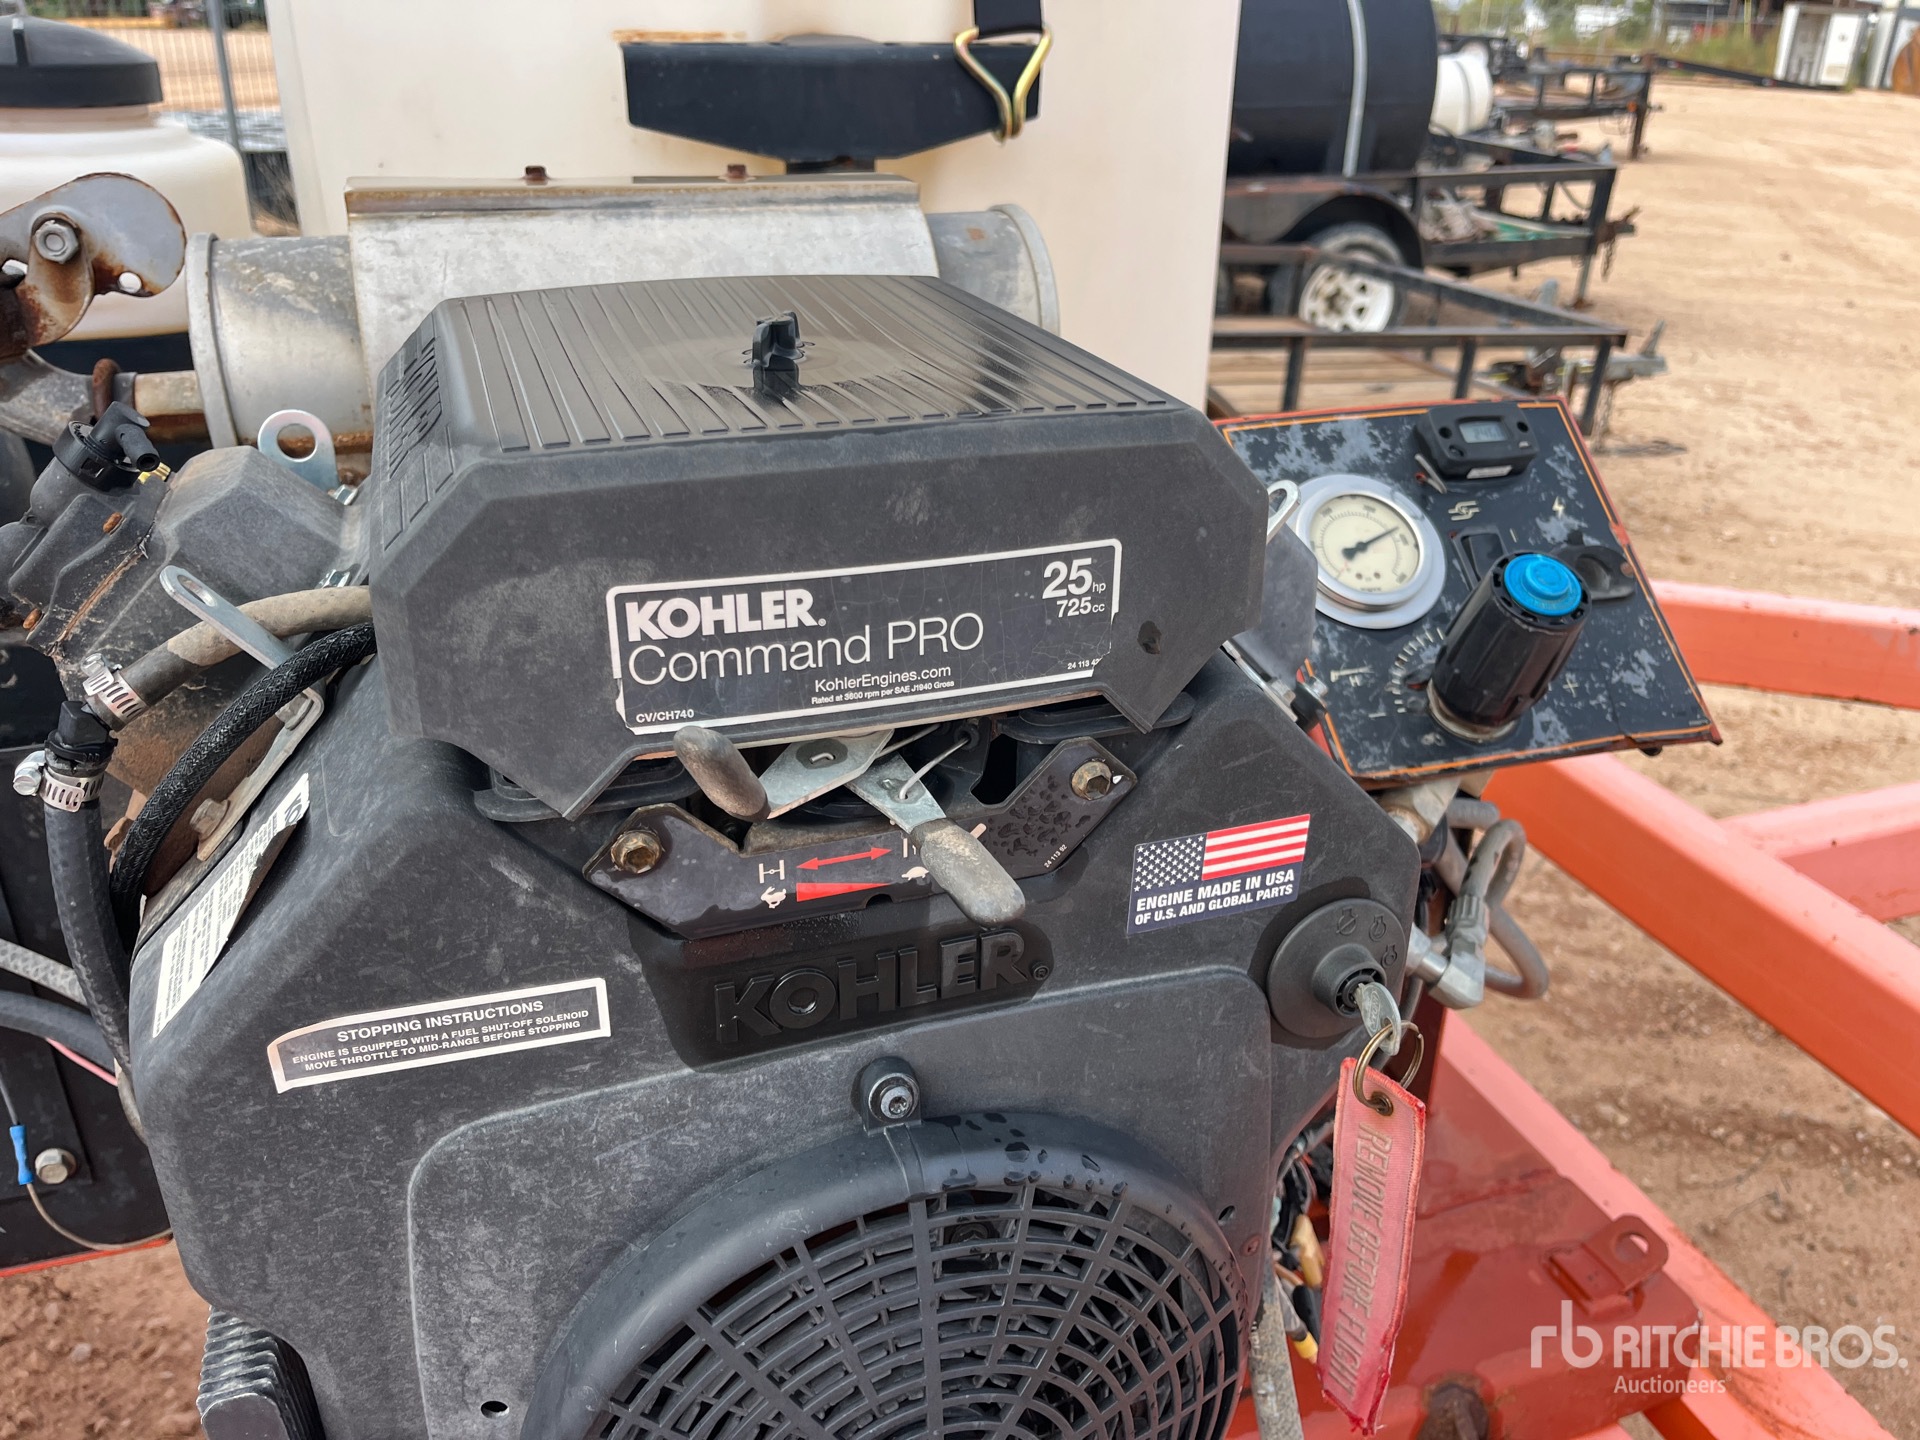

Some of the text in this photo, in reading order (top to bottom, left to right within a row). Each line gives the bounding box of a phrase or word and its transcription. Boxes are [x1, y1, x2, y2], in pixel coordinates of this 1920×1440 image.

[1042, 558, 1106, 599] 25 hp
[1056, 598, 1105, 618] 725 cc
[628, 612, 984, 686] Command PRO
[1067, 662, 1076, 670] 24
[812, 695, 834, 705] Rated
[864, 690, 880, 700] rpm
[881, 689, 893, 698] per
[894, 685, 910, 694] SAE
[911, 682, 932, 692] J1940
[933, 680, 955, 689] Gross
[814, 666, 951, 693] KohlerEngines.com
[636, 709, 695, 724] CV/CH740
[1135, 883, 1293, 926] OF U.S. AND GLOBAL PARTS
[1136, 868, 1295, 912] ENGINE MADE IN USA
[292, 1010, 589, 1065] ENGINE IS EQUIPPED WITH A FUEL SHUT-OFF SOLENOID
[337, 1000, 544, 1043] STOPPING INSTRUCTIONS
[305, 1020, 581, 1071] MOVE THROTTLE TO MID-RANGE BEFORE STOPPING
[1329, 1122, 1393, 1397] REMOVE BEFORE FLIGHT
